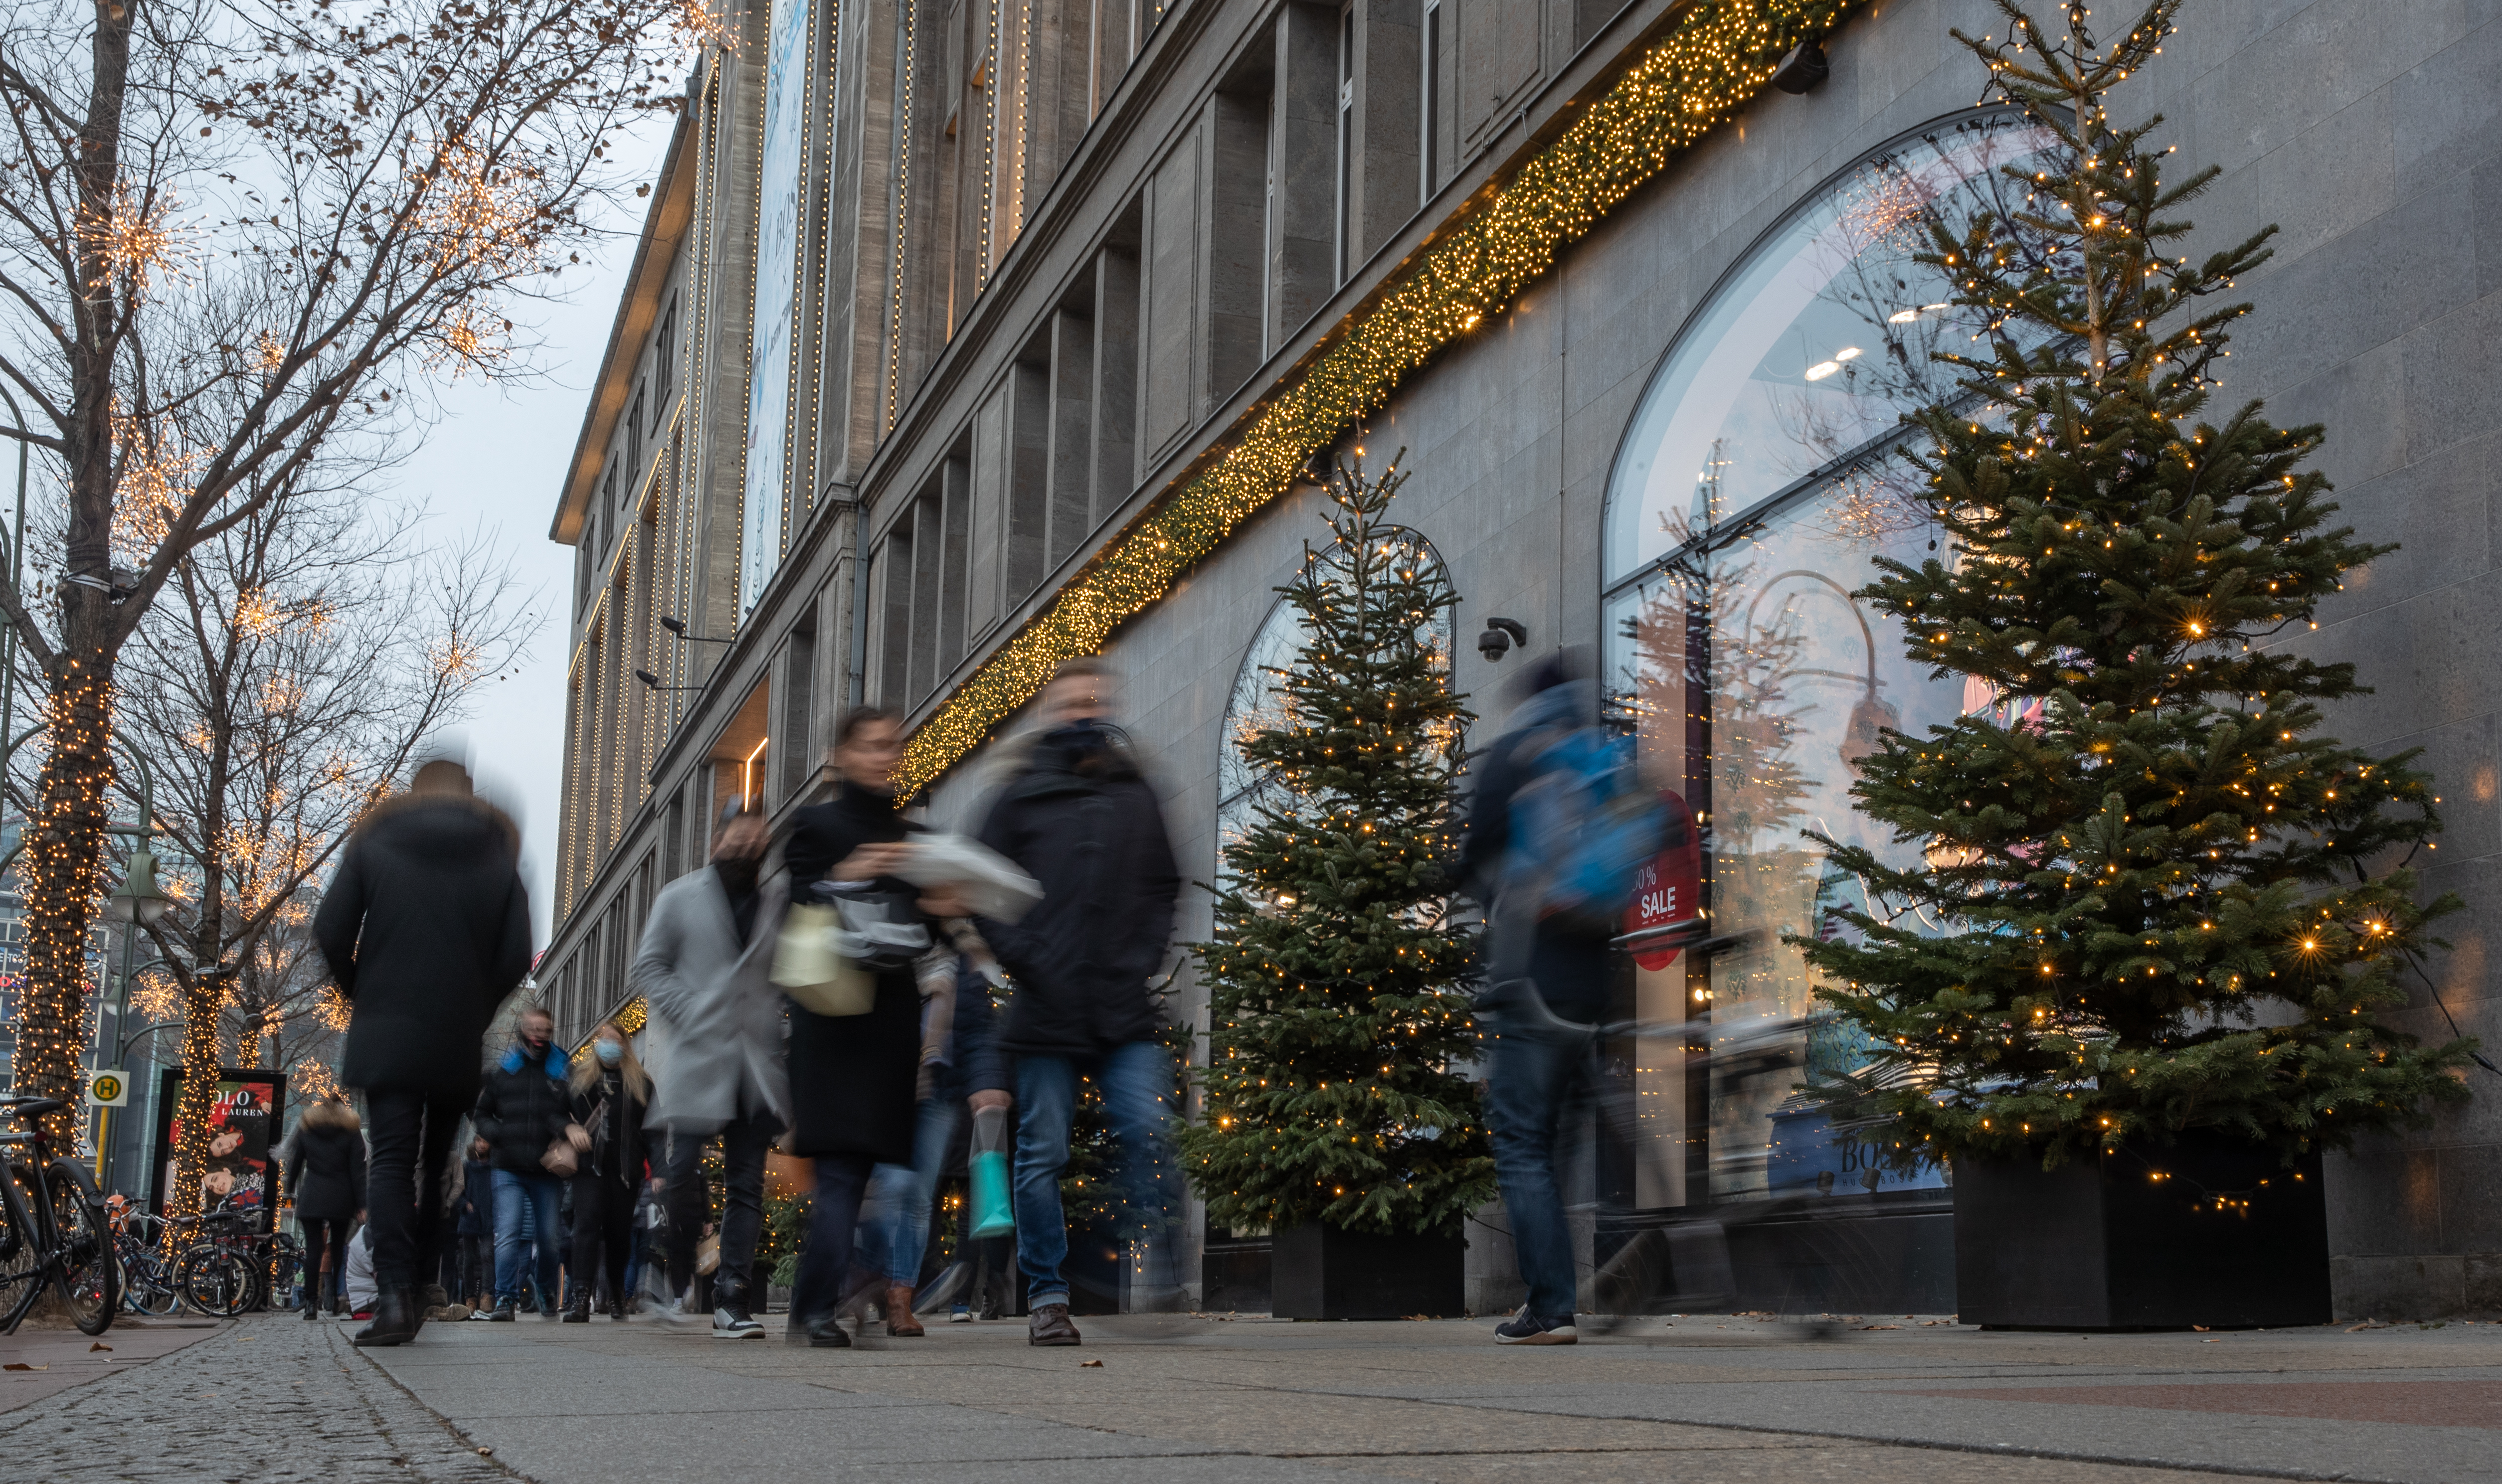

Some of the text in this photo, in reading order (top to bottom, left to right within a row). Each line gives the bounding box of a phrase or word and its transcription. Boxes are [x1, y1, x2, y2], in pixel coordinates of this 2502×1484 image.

[1641, 886, 1675, 918] SALE
[100, 1081, 114, 1095] H
[222, 1108, 263, 1117] LAUREN
[1881, 1173, 1913, 1184] BOSS
